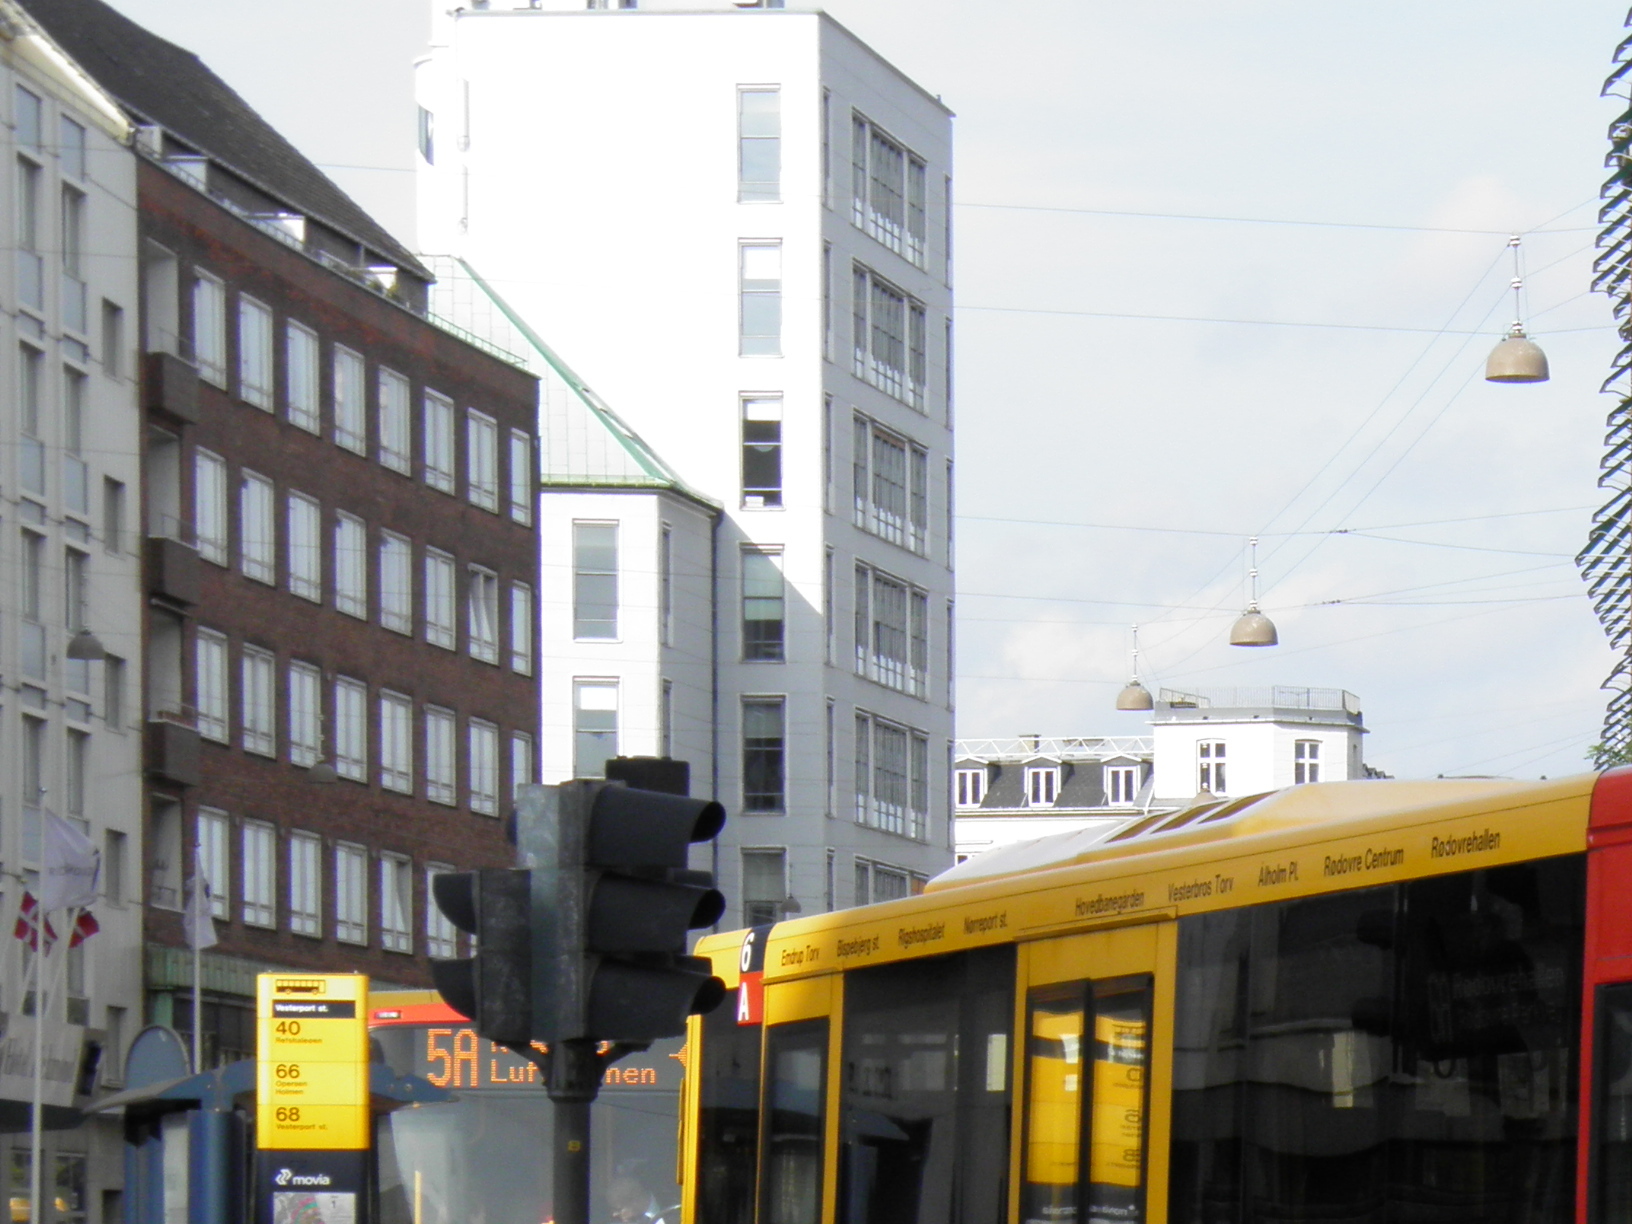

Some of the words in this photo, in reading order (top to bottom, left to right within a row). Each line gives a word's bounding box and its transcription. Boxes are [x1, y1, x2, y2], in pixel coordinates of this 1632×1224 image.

[1430, 828, 1501, 859] Rødovrehallen
[1323, 853, 1363, 878] Rødovre
[1364, 847, 1405, 871] Centrum
[1168, 880, 1212, 902] Vesterbros
[1215, 874, 1235, 893] Torv
[741, 931, 754, 972] 6
[781, 946, 804, 967] Emdrup
[805, 944, 820, 961] Torv
[837, 935, 871, 957] Bispebjerg
[275, 1003, 316, 1014] Vesterport
[317, 1004, 328, 1013] st.
[738, 981, 749, 1022] A
[275, 1020, 301, 1036] 40
[427, 1028, 477, 1088] 5A
[275, 1063, 301, 1079] 66
[275, 1106, 301, 1122] 68
[276, 1123, 316, 1131] Vesterport
[292, 1173, 331, 1186] movia
